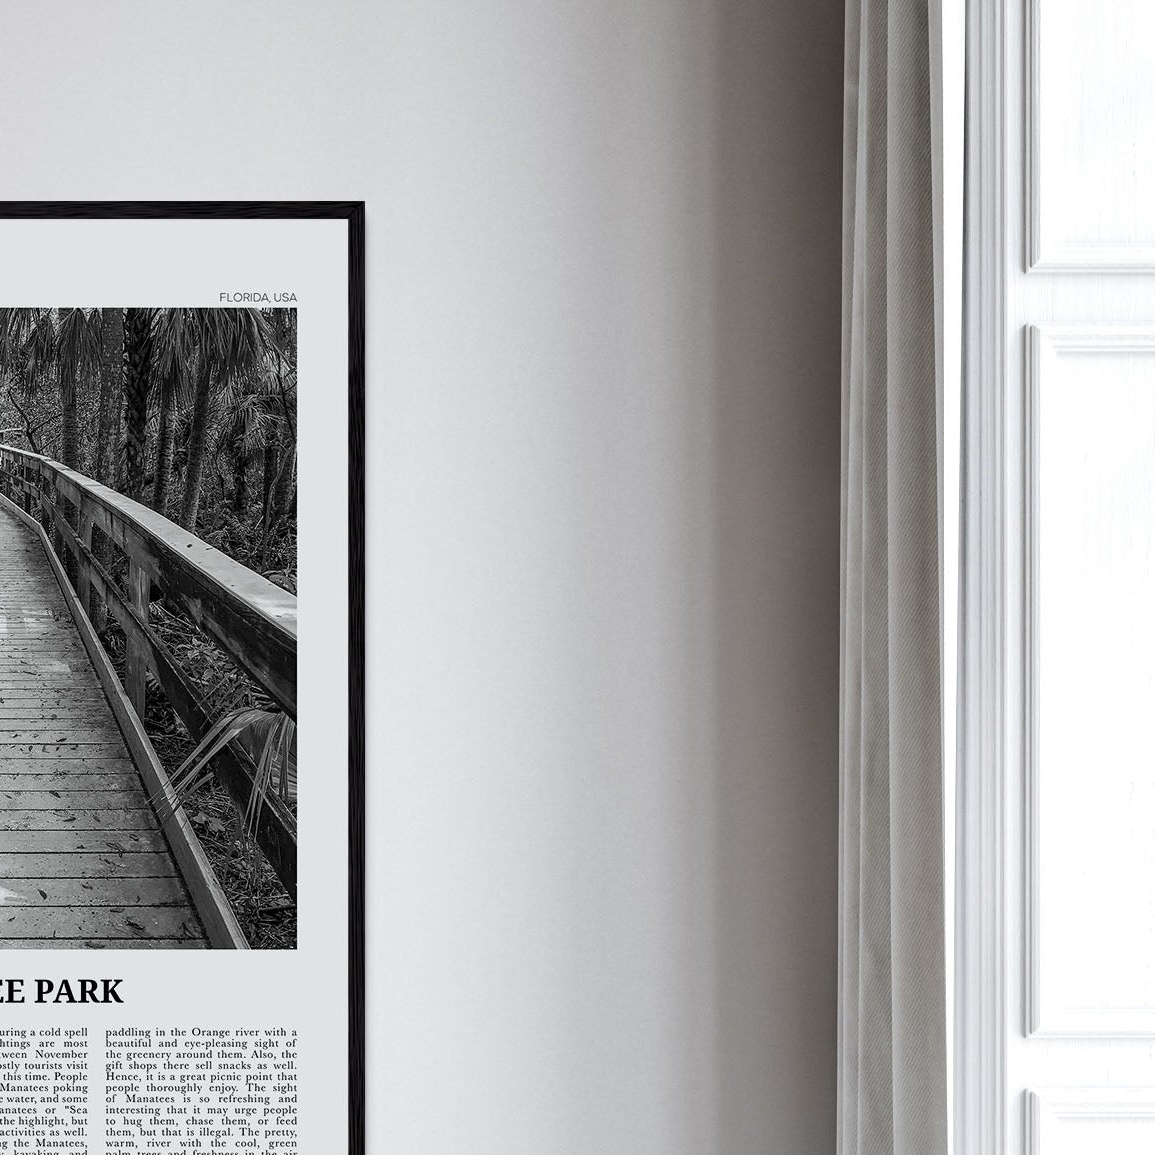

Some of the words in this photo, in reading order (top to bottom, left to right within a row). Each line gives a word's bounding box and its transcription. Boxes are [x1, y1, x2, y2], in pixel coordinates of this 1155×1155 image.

[219, 292, 271, 303] FLORIDA,
[273, 292, 298, 303] USA
[34, 979, 124, 1003] PARK
[39, 1027, 61, 1037] cold
[64, 1027, 88, 1039] spell
[105, 1027, 151, 1039] paddling
[156, 1028, 165, 1037] in
[170, 1027, 187, 1037] the
[191, 1027, 230, 1039] Orange
[235, 1028, 260, 1037] river
[264, 1027, 286, 1037] with
[35, 1049, 88, 1059] November
[106, 1049, 122, 1059] the
[126, 1052, 171, 1061] greenery
[176, 1049, 213, 1059] around
[217, 1049, 246, 1059] them.
[251, 1049, 277, 1060] Also,
[281, 1049, 297, 1059] the
[24, 1061, 63, 1070] tourists
[66, 1061, 88, 1070] visit
[105, 1060, 123, 1072] gift
[129, 1060, 157, 1072] shops
[163, 1060, 189, 1070] there
[195, 1060, 212, 1070] sell
[218, 1060, 251, 1070] snacks
[273, 1060, 297, 1070] well.
[3, 1072, 22, 1081] this
[25, 1072, 50, 1081] time.
[54, 1072, 88, 1084] People
[106, 1072, 142, 1083] Hence,
[146, 1072, 153, 1081] it
[158, 1072, 166, 1081] is
[180, 1073, 206, 1084] great
[210, 1072, 241, 1084] picnic
[246, 1072, 273, 1084] point
[277, 1072, 297, 1081] that
[6, 1095, 37, 1105] water,
[40, 1094, 59, 1103] and
[65, 1105, 88, 1114] "Sea
[105, 1105, 161, 1117] interesting
[167, 1105, 187, 1114] that
[193, 1105, 201, 1114] it
[207, 1108, 228, 1117] may
[234, 1108, 257, 1117] urge
[263, 1105, 297, 1117] people
[0, 1127, 46, 1136] activities
[64, 1127, 87, 1136] well.
[106, 1127, 135, 1138] them,
[140, 1127, 156, 1136] but
[161, 1127, 182, 1136] that
[186, 1127, 195, 1136] is
[199, 1127, 234, 1139] illegal.
[240, 1127, 260, 1136] The
[264, 1128, 297, 1139] pretty,
[105, 1141, 138, 1149] warm,
[147, 1139, 171, 1148] river
[179, 1138, 202, 1148] with
[210, 1138, 227, 1148] the
[235, 1138, 260, 1149] cool,
[268, 1141, 297, 1150] green
